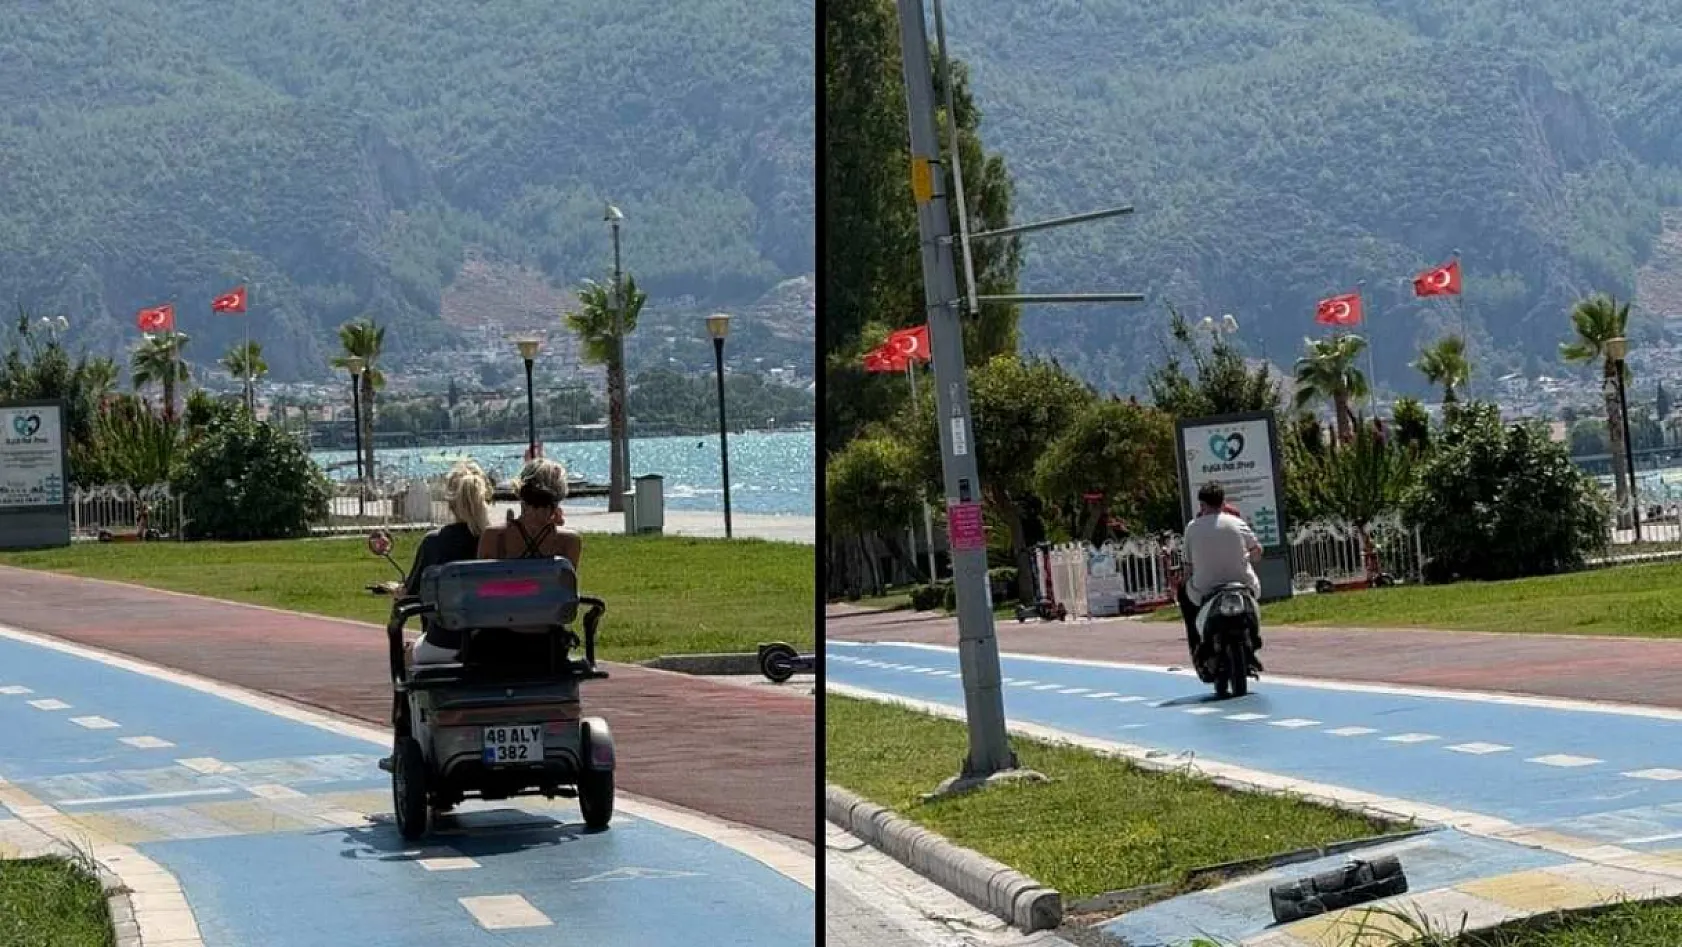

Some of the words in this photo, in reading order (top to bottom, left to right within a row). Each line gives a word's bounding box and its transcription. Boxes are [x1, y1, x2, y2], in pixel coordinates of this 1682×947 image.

[487, 729, 506, 743] 48
[510, 727, 540, 743] ALY
[497, 745, 528, 759] 382
